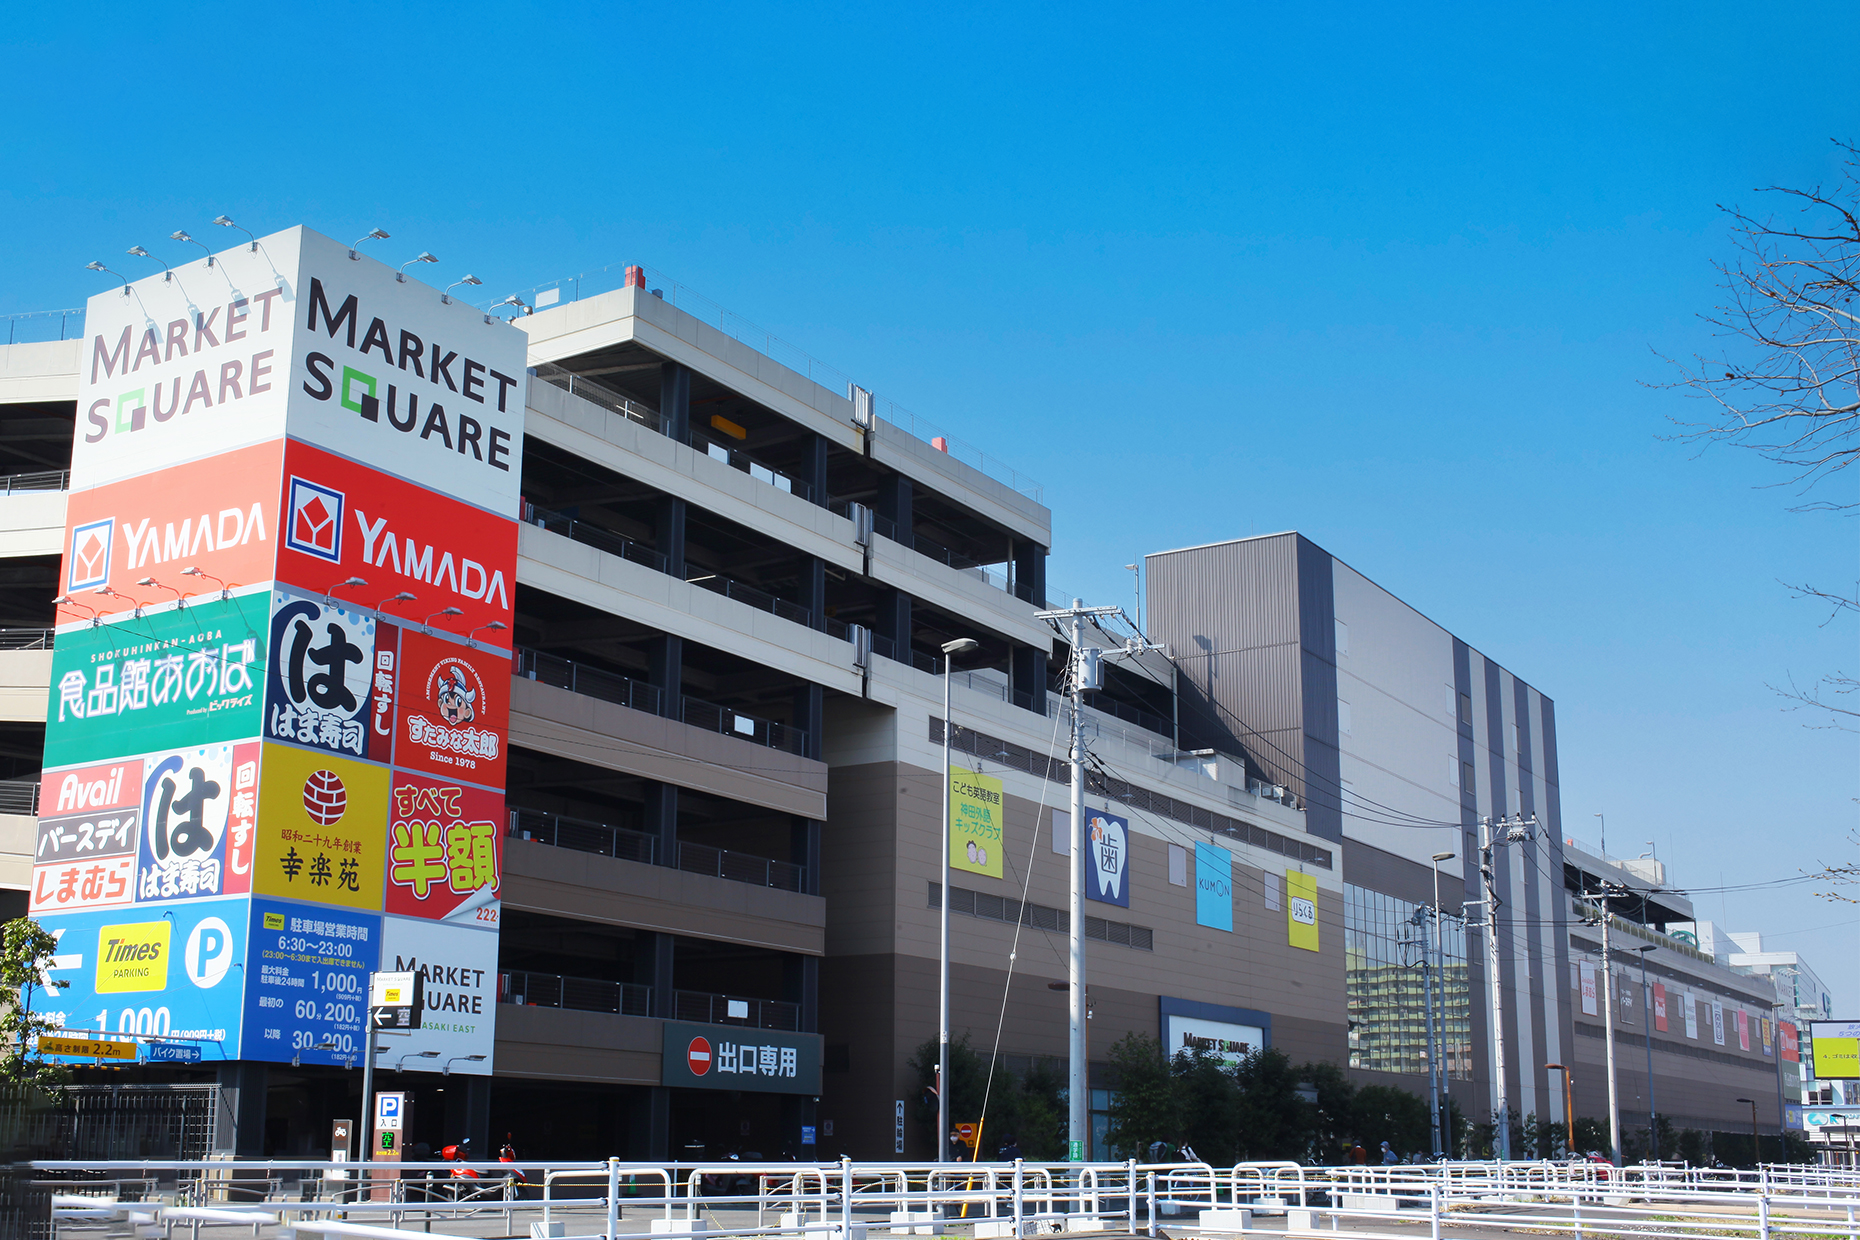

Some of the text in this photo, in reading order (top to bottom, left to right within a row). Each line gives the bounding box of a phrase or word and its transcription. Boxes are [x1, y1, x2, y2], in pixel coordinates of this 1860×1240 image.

[90, 287, 283, 385] MARKET
[307, 276, 517, 414] MARKET
[122, 502, 266, 570] YAMADA
[354, 509, 509, 610] YAMADA
[90, 629, 222, 663] SHOKUHINKAN-AOBA
[58, 638, 256, 723] 食品館あおば
[288, 618, 364, 713] は
[374, 650, 395, 736] 回転すし
[270, 703, 364, 756] はま寿司
[408, 716, 498, 759] すたみな太郎
[430, 751, 476, 769] Since 1978
[57, 767, 124, 812] Avail
[394, 784, 462, 817] すべて
[953, 780, 1000, 805] こども英語教室
[155, 767, 222, 860] は
[230, 760, 257, 875] 回転すし
[960, 802, 991, 824] 神田外語
[38, 816, 135, 857] バースデイ
[281, 829, 362, 854] 昭和二十九年創業
[1099, 833, 1119, 875] 歯
[280, 846, 360, 892] 幸楽苑
[391, 819, 500, 900] 半額
[35, 862, 130, 905] しまむら
[139, 858, 220, 900] はま寿司
[1199, 877, 1230, 897] KUMON
[266, 915, 283, 924] Times
[290, 917, 369, 942] 駐車場営業時間
[105, 938, 161, 963] Times
[196, 927, 224, 978] P
[113, 968, 150, 979] PARKING
[261, 965, 289, 976] 最大料金
[259, 996, 284, 1008] 最初の
[264, 1028, 281, 1040] 以降
[452, 1024, 476, 1034] EAST
[55, 1043, 121, 1056] 高さ制限 2.2m
[153, 1046, 191, 1059] バイク置場
[717, 1041, 797, 1078] 出口専用
[380, 1119, 397, 1127] 入口
[382, 1098, 397, 1116] P
[382, 1132, 394, 1148] 空
